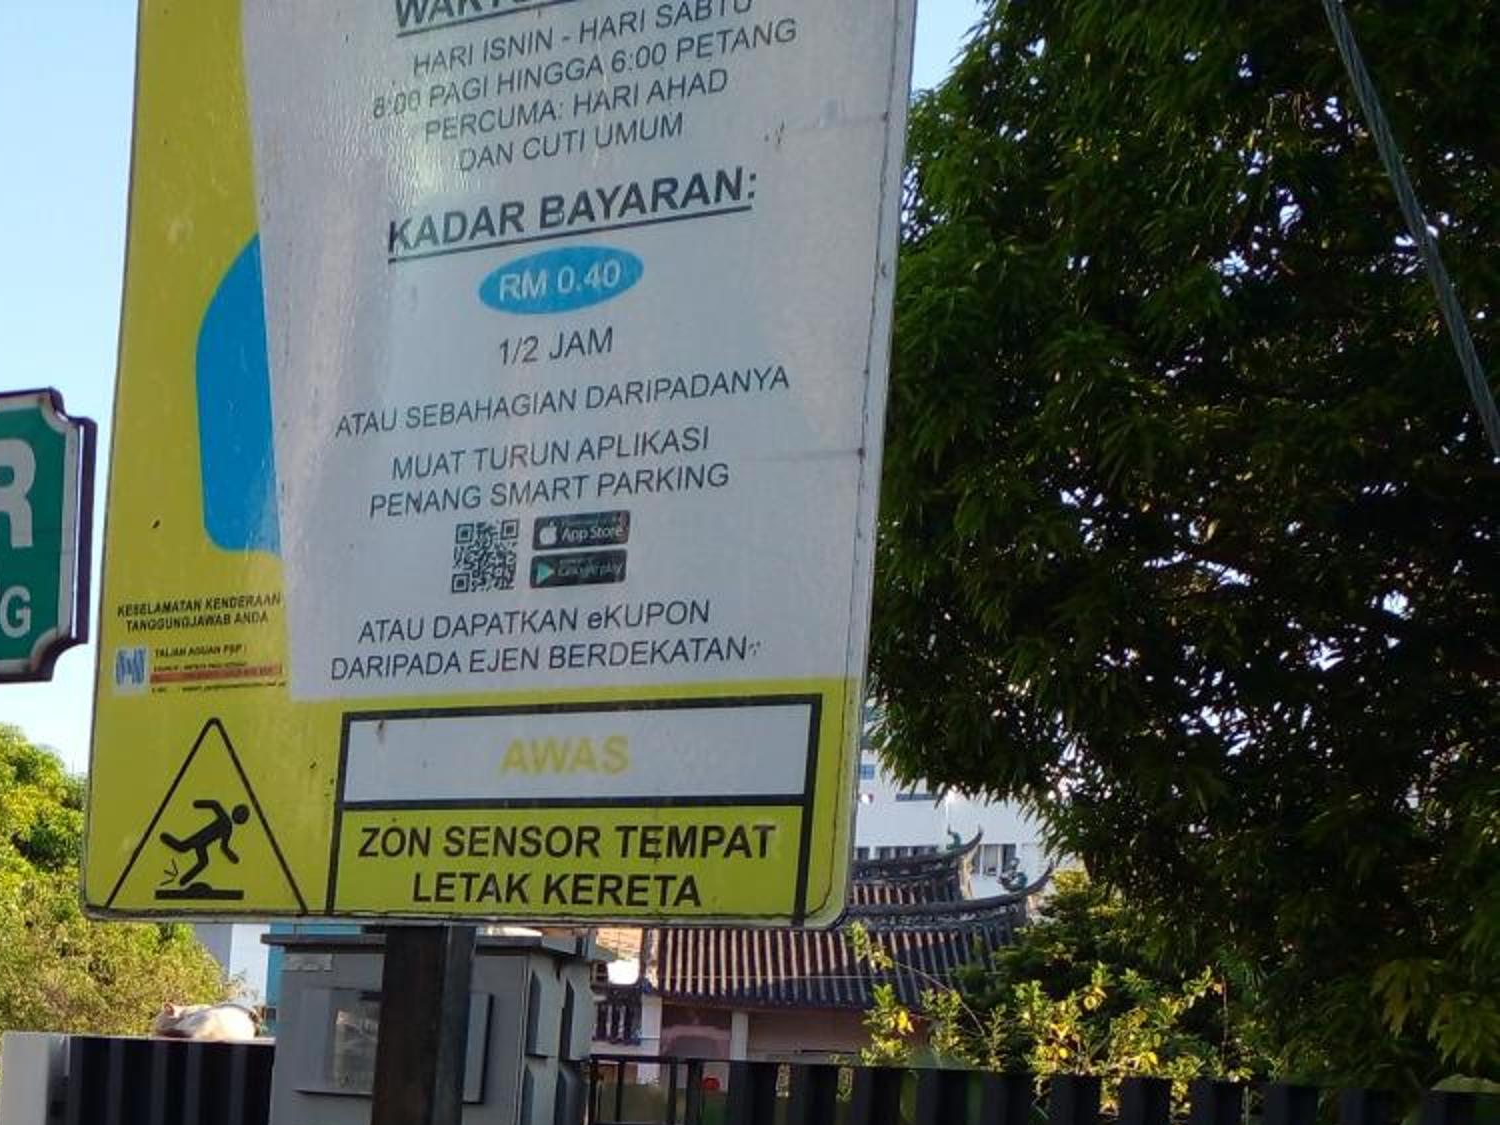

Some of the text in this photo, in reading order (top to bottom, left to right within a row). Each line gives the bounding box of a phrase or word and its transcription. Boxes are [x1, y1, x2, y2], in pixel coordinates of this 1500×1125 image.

[413, 45, 473, 76] HARI
[483, 32, 553, 62] ISNIN
[579, 9, 645, 45] HARI
[373, 18, 797, 120] 8:00 PAGI HINGGA 6:00 PETANG
[424, 69, 728, 143] PERCUMA: HARI AHAD
[458, 113, 684, 172] DAN CUTI UMUM
[388, 167, 757, 255] KADAR BAYARAN:
[499, 258, 622, 300] RM 0.40
[499, 328, 614, 367] 1/2 JAM
[335, 365, 790, 437] ATAU SEBAHAGIAN DARIPADANYA
[392, 427, 709, 482] MUAT TURUN APLIKASI
[369, 463, 729, 519] PENANG SMART PARKING
[234, 611, 269, 625] ANDA
[357, 600, 710, 644] ATAU DAPATKAN eKUPON
[331, 652, 464, 682] DARIPADA
[469, 647, 540, 676] EJEN
[502, 736, 630, 775] AWAS
[358, 823, 776, 859] ZON SENSOR TEMPAT
[412, 873, 701, 907] LETAK KERETA
